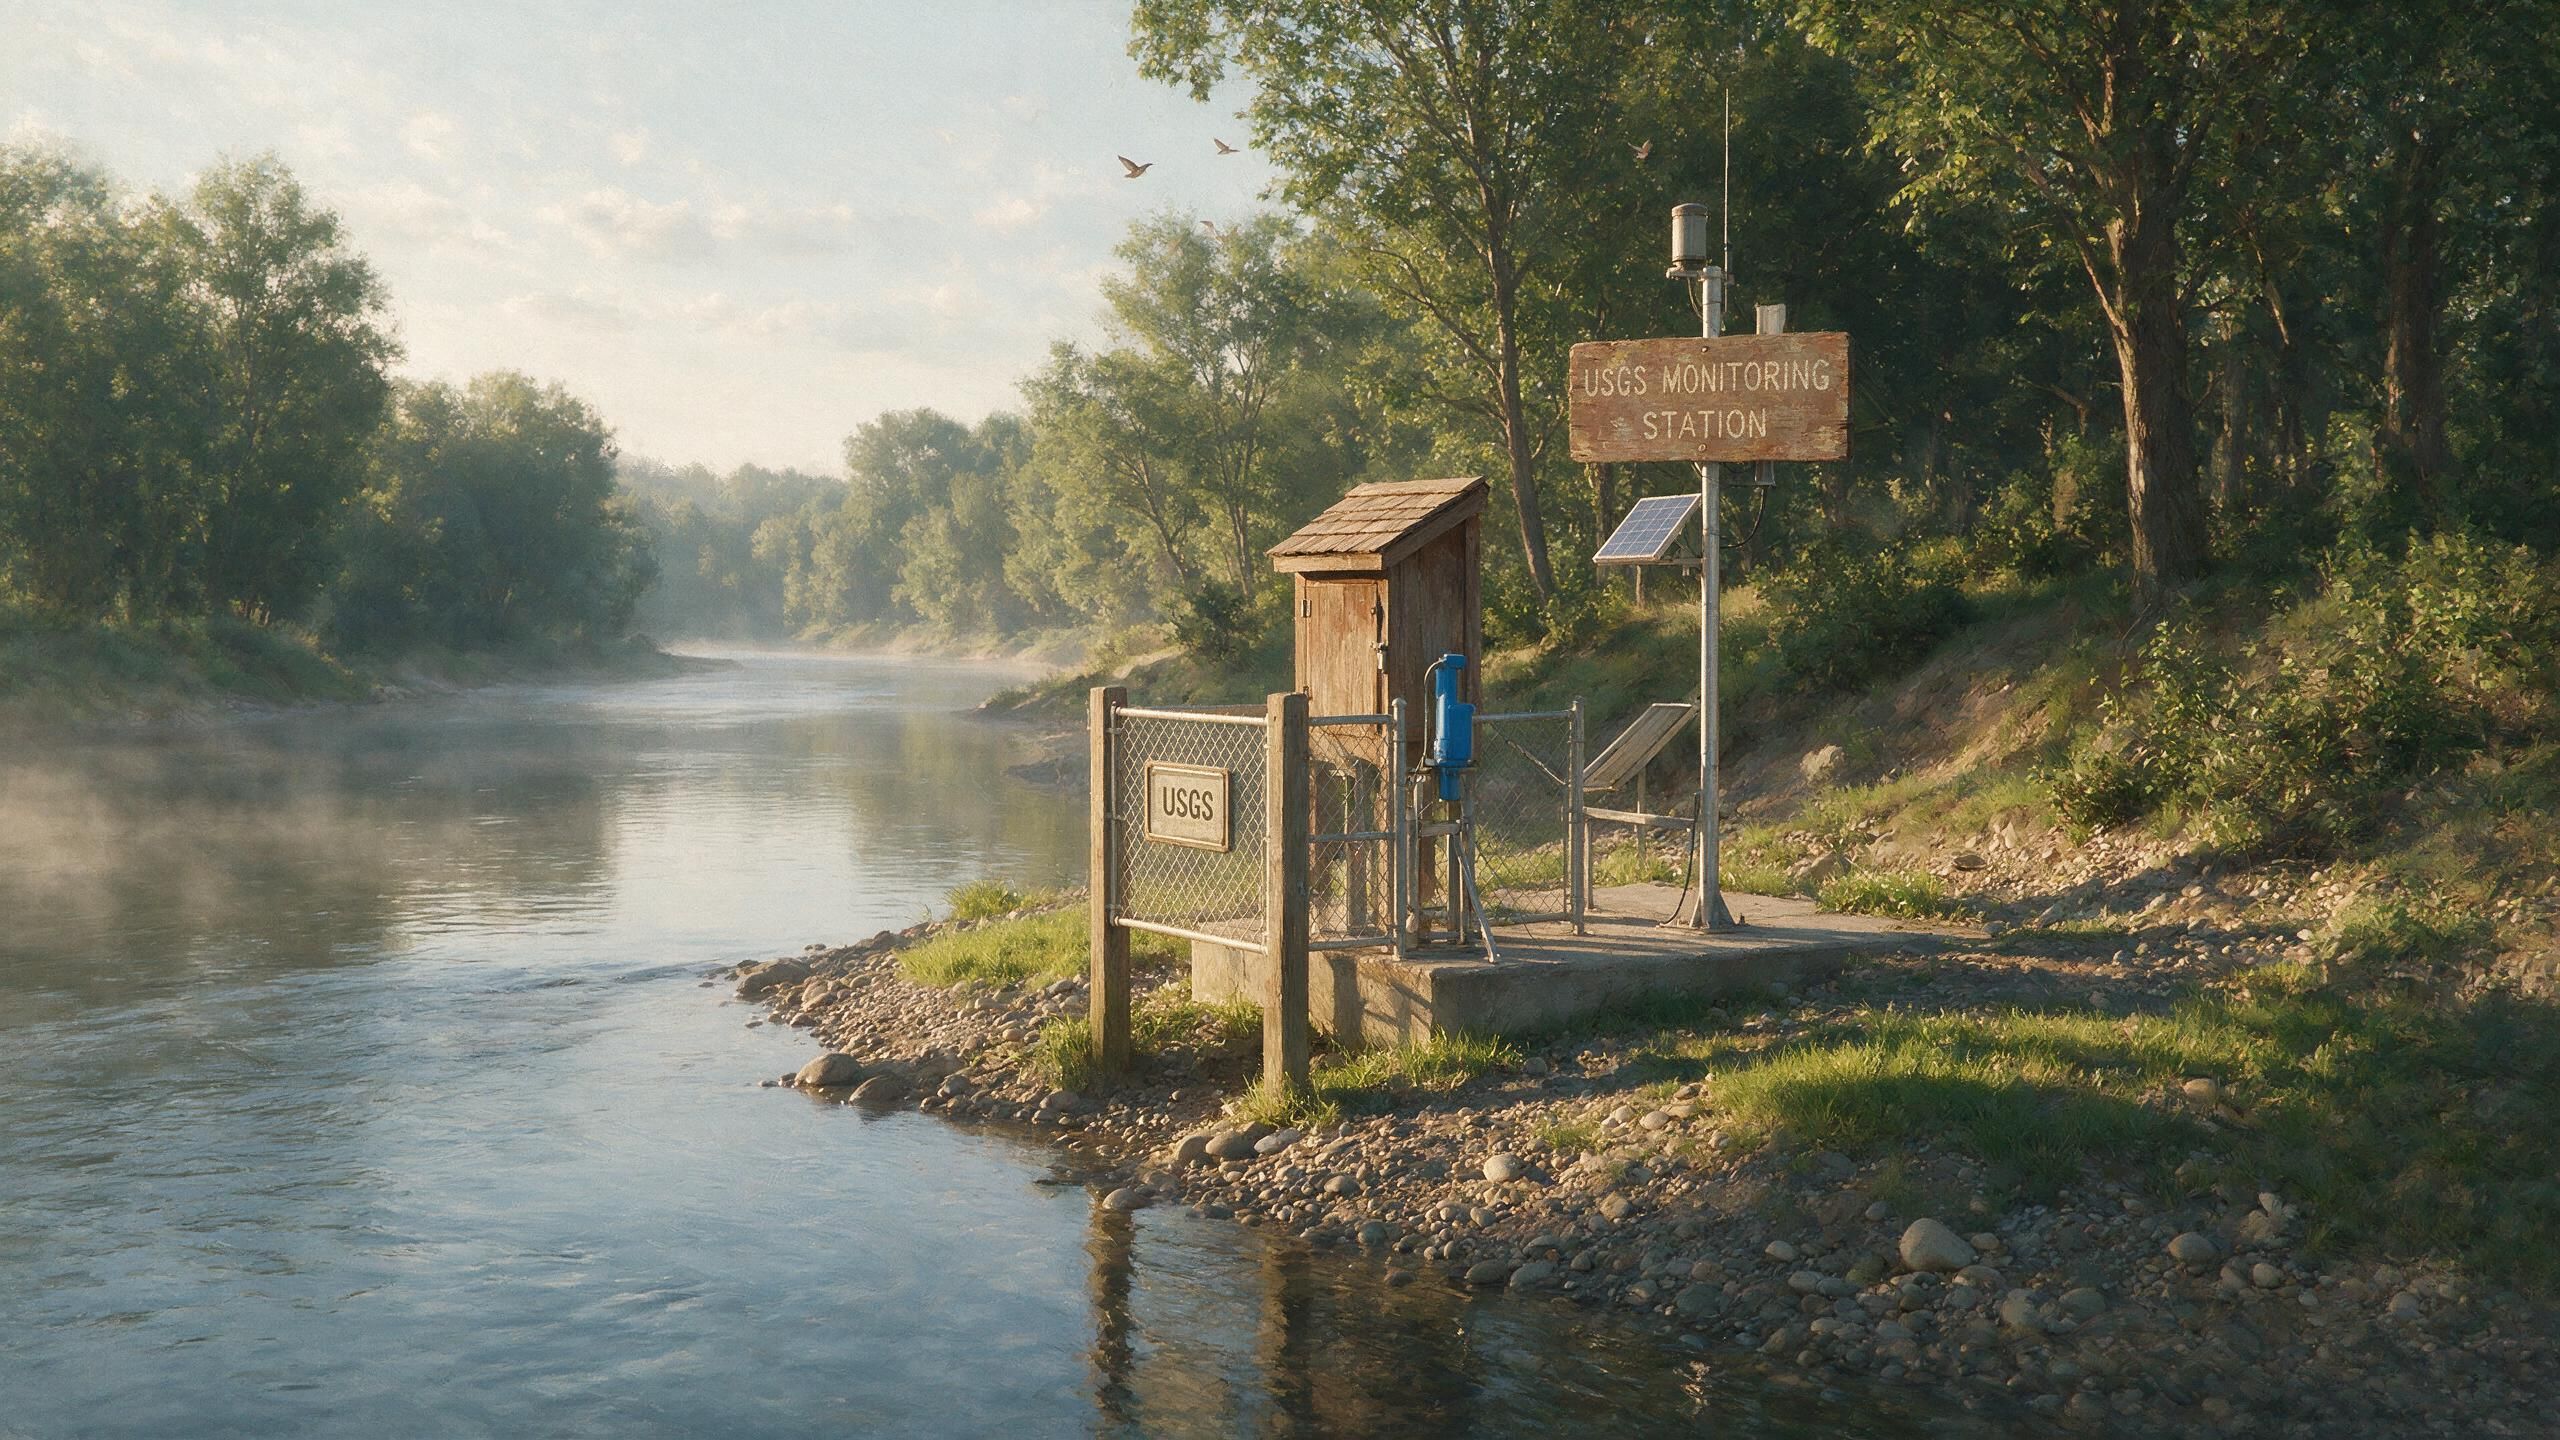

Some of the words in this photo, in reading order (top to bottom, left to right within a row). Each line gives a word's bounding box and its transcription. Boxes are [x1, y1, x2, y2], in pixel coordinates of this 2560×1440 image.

[1584, 365, 1648, 397] USGS
[1662, 358, 1831, 395] MONITORING
[1642, 407, 1768, 440] STATION
[1162, 786, 1214, 821] USGS
